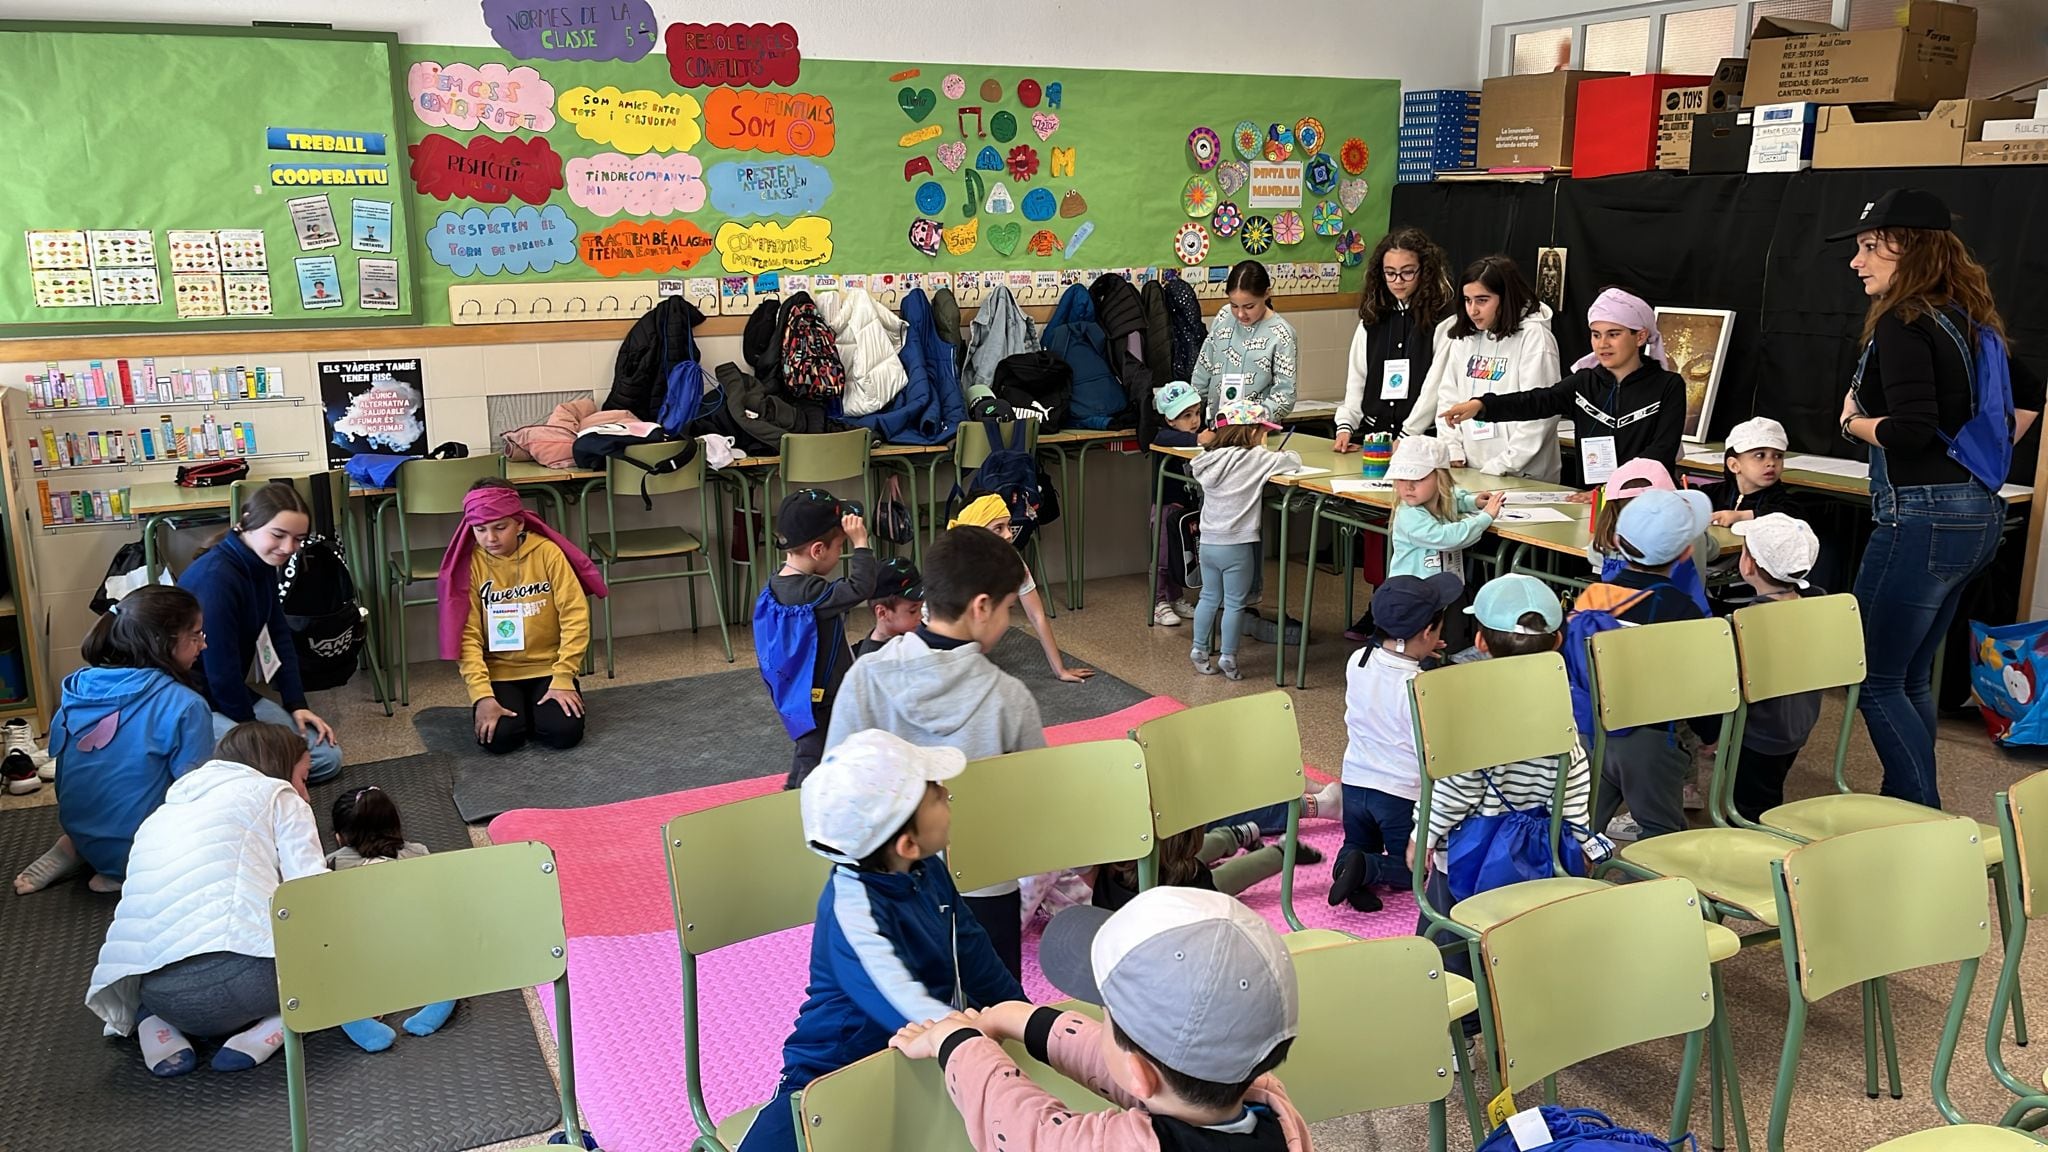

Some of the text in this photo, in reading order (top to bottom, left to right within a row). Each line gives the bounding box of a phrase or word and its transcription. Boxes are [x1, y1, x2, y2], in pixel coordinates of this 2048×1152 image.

[507, 2, 631, 32] NORMES DE LA
[541, 29, 598, 49] CLASSE
[1814, 59, 1830, 67] KGS
[1779, 80, 1810, 88] MEDIDAS:
[1777, 88, 1814, 97] CANTIDAD:
[583, 94, 610, 106] SOM
[1682, 90, 1704, 110] TOYS
[571, 107, 597, 117] TOTS
[729, 105, 776, 138] SOM
[2015, 123, 2048, 133] RULET
[1508, 126, 1534, 134] innovación
[287, 133, 367, 153] TREBALL
[272, 168, 388, 186] COOPERATIU
[737, 165, 798, 182] PRESTEM
[1253, 167, 1301, 179] PINTA UN
[760, 187, 799, 200] CLASSE
[1252, 185, 1301, 197] MANDALA
[446, 218, 556, 236] RESPECTEM EL
[583, 232, 650, 248] TRACTEM
[652, 228, 669, 247] BÉ
[951, 234, 976, 247] Sara
[448, 237, 554, 257] TORN DE PARAULA
[900, 273, 919, 281] ALEX
[323, 364, 340, 373] ELS
[386, 360, 416, 370] TAMBÉ
[340, 373, 392, 383] TENEN RISC
[360, 399, 409, 408] ALTERNATIVA
[362, 408, 405, 416] SALUDABLE
[357, 417, 382, 425] FUMAR
[480, 580, 551, 609] Awesome
[308, 626, 354, 651] VANS
